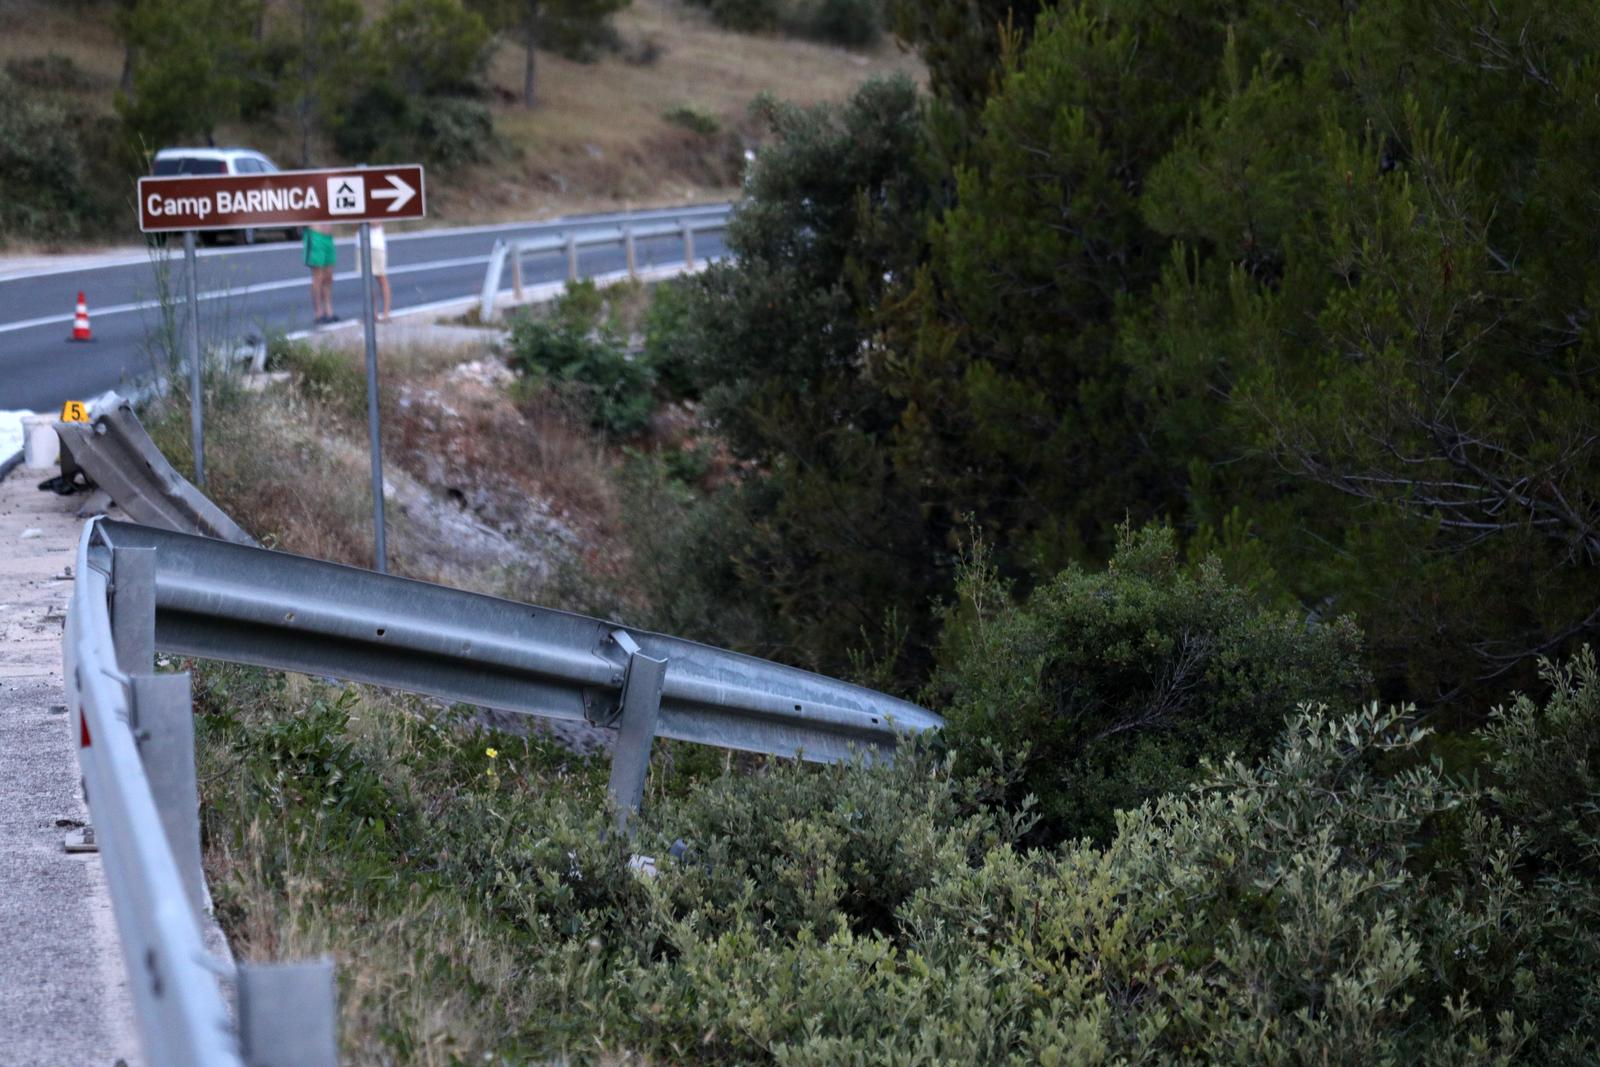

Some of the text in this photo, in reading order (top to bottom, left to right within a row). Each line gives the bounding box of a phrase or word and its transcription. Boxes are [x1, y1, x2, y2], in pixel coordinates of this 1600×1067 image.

[148, 187, 320, 219] Camp BARINICA
[71, 404, 80, 421] 5
